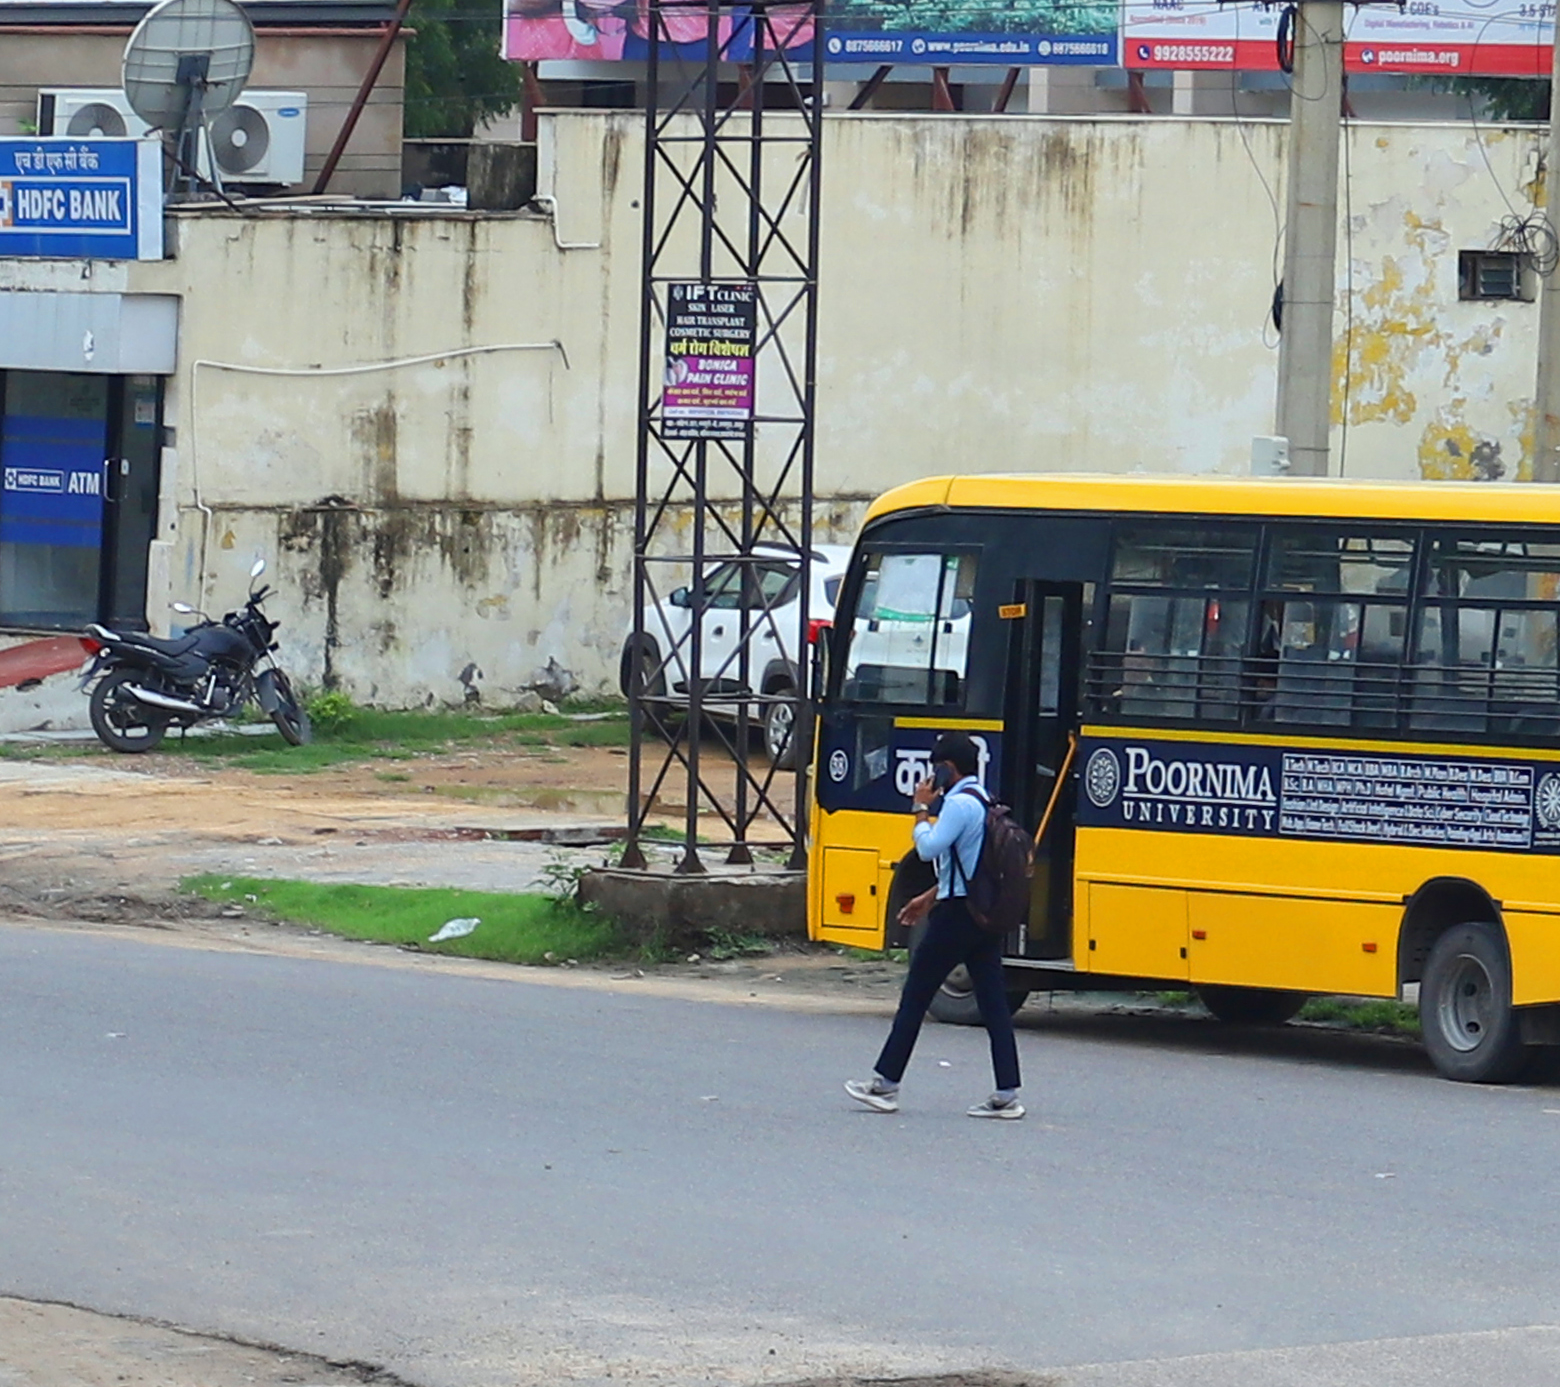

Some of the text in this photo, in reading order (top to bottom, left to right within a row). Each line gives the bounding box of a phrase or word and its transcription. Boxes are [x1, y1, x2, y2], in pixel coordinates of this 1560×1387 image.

[1154, 45, 1234, 62] 9928555222
[1378, 49, 1459, 66] poornima.org
[17, 188, 121, 222] HDFC BANK
[717, 290, 753, 303] CLINIC
[711, 303, 735, 314] LASER
[697, 315, 746, 327] TRANSPLANT
[670, 327, 712, 337] COSMETIC
[713, 373, 749, 386] CLINIC
[17, 471, 100, 495] HDFC BANK ATM
[1124, 747, 1277, 802] POORNIMA
[1122, 800, 1276, 830] UNIVERSITY
